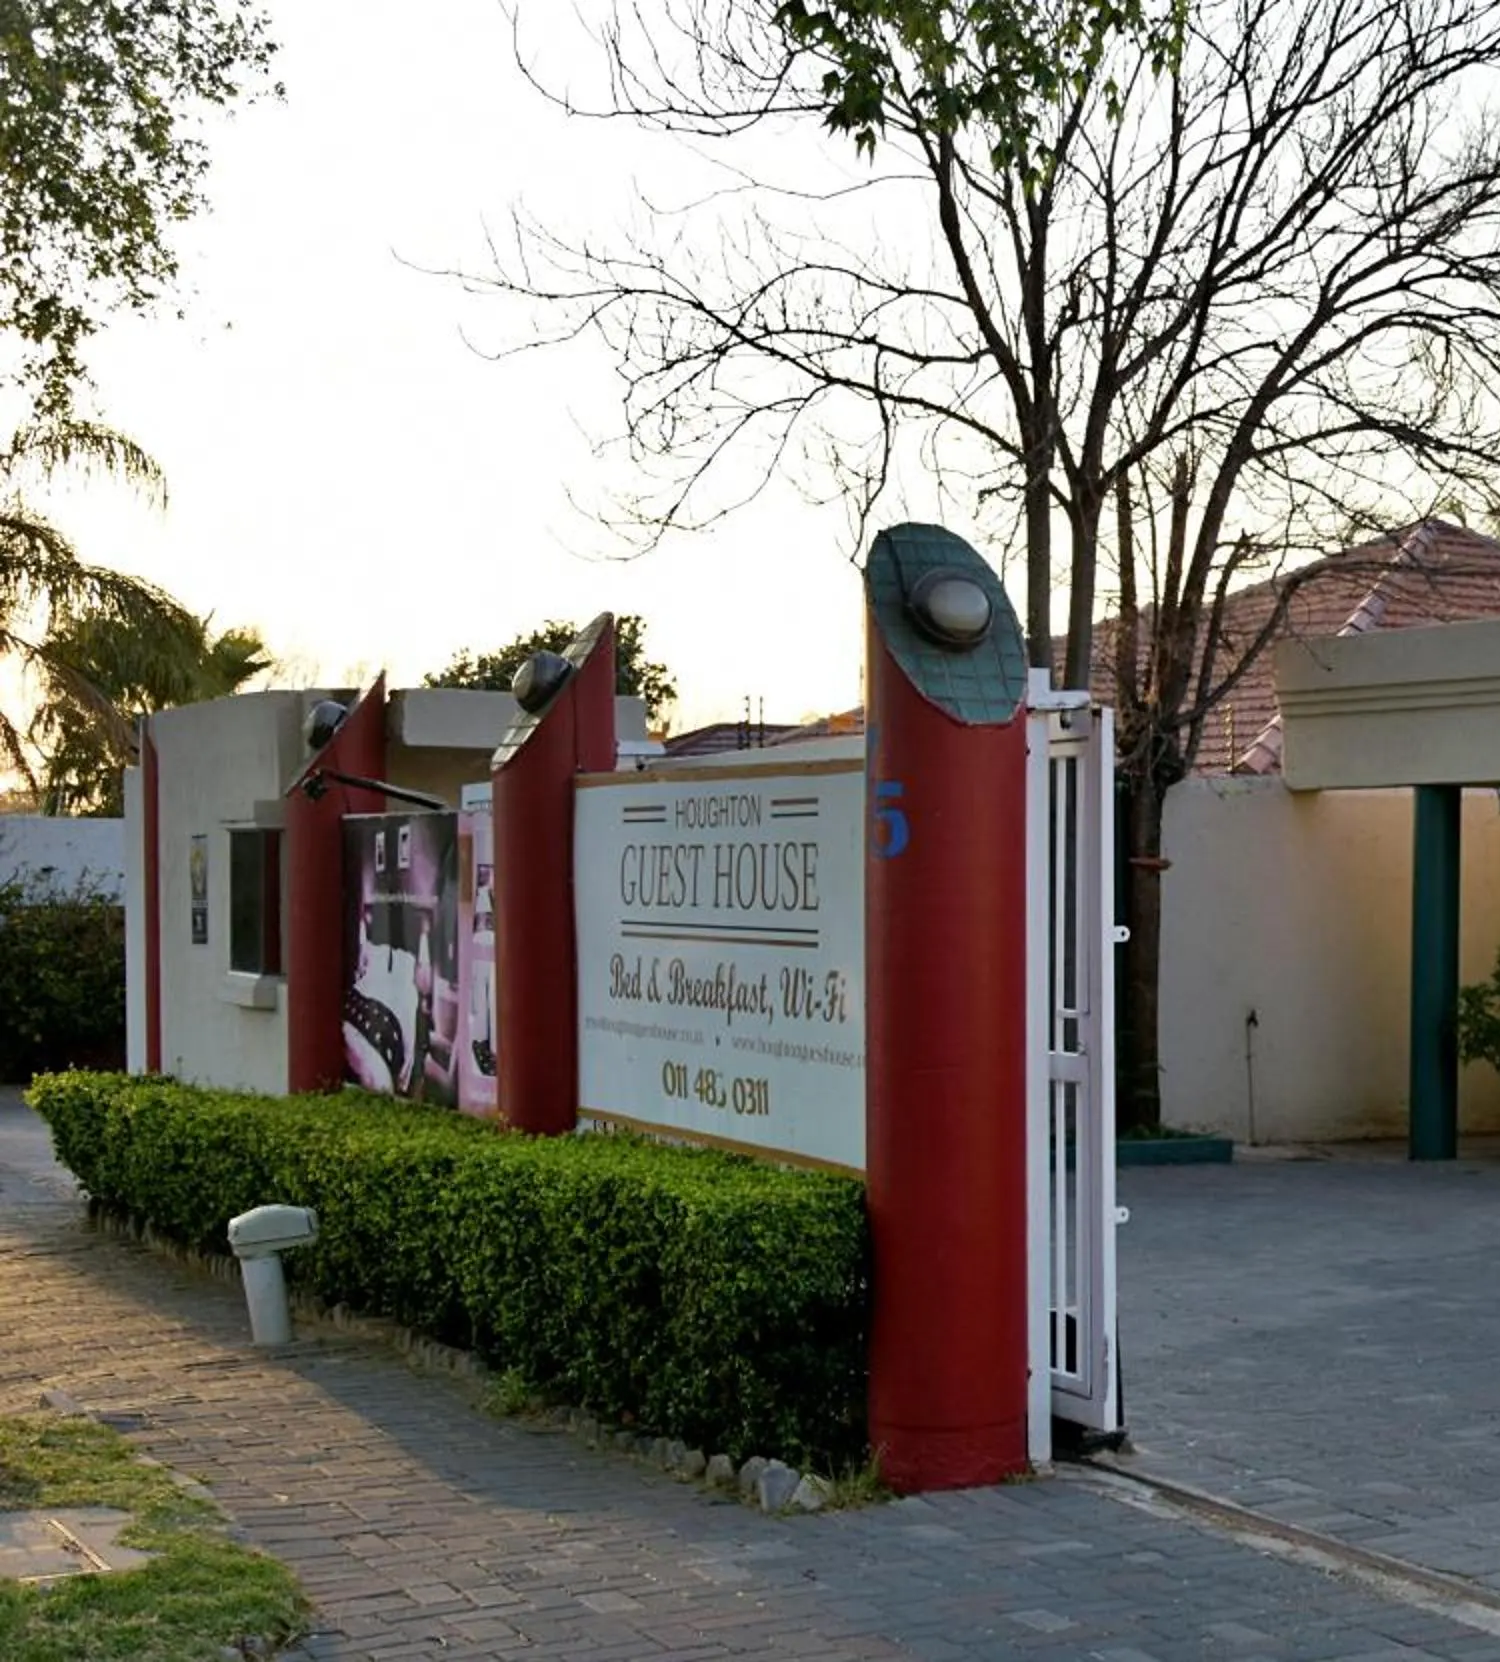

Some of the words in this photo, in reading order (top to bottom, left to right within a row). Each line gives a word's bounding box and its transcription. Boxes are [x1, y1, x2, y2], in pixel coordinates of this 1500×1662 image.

[675, 795, 761, 828] HOUGHTON
[621, 844, 704, 908] GUEST
[713, 841, 820, 912] HOUSE
[609, 953, 642, 1001] Bed
[667, 957, 773, 1026] Breakfast,
[780, 966, 847, 1024] Wi-Fi
[662, 1060, 688, 1100] 011
[732, 1077, 769, 1116] 0311
